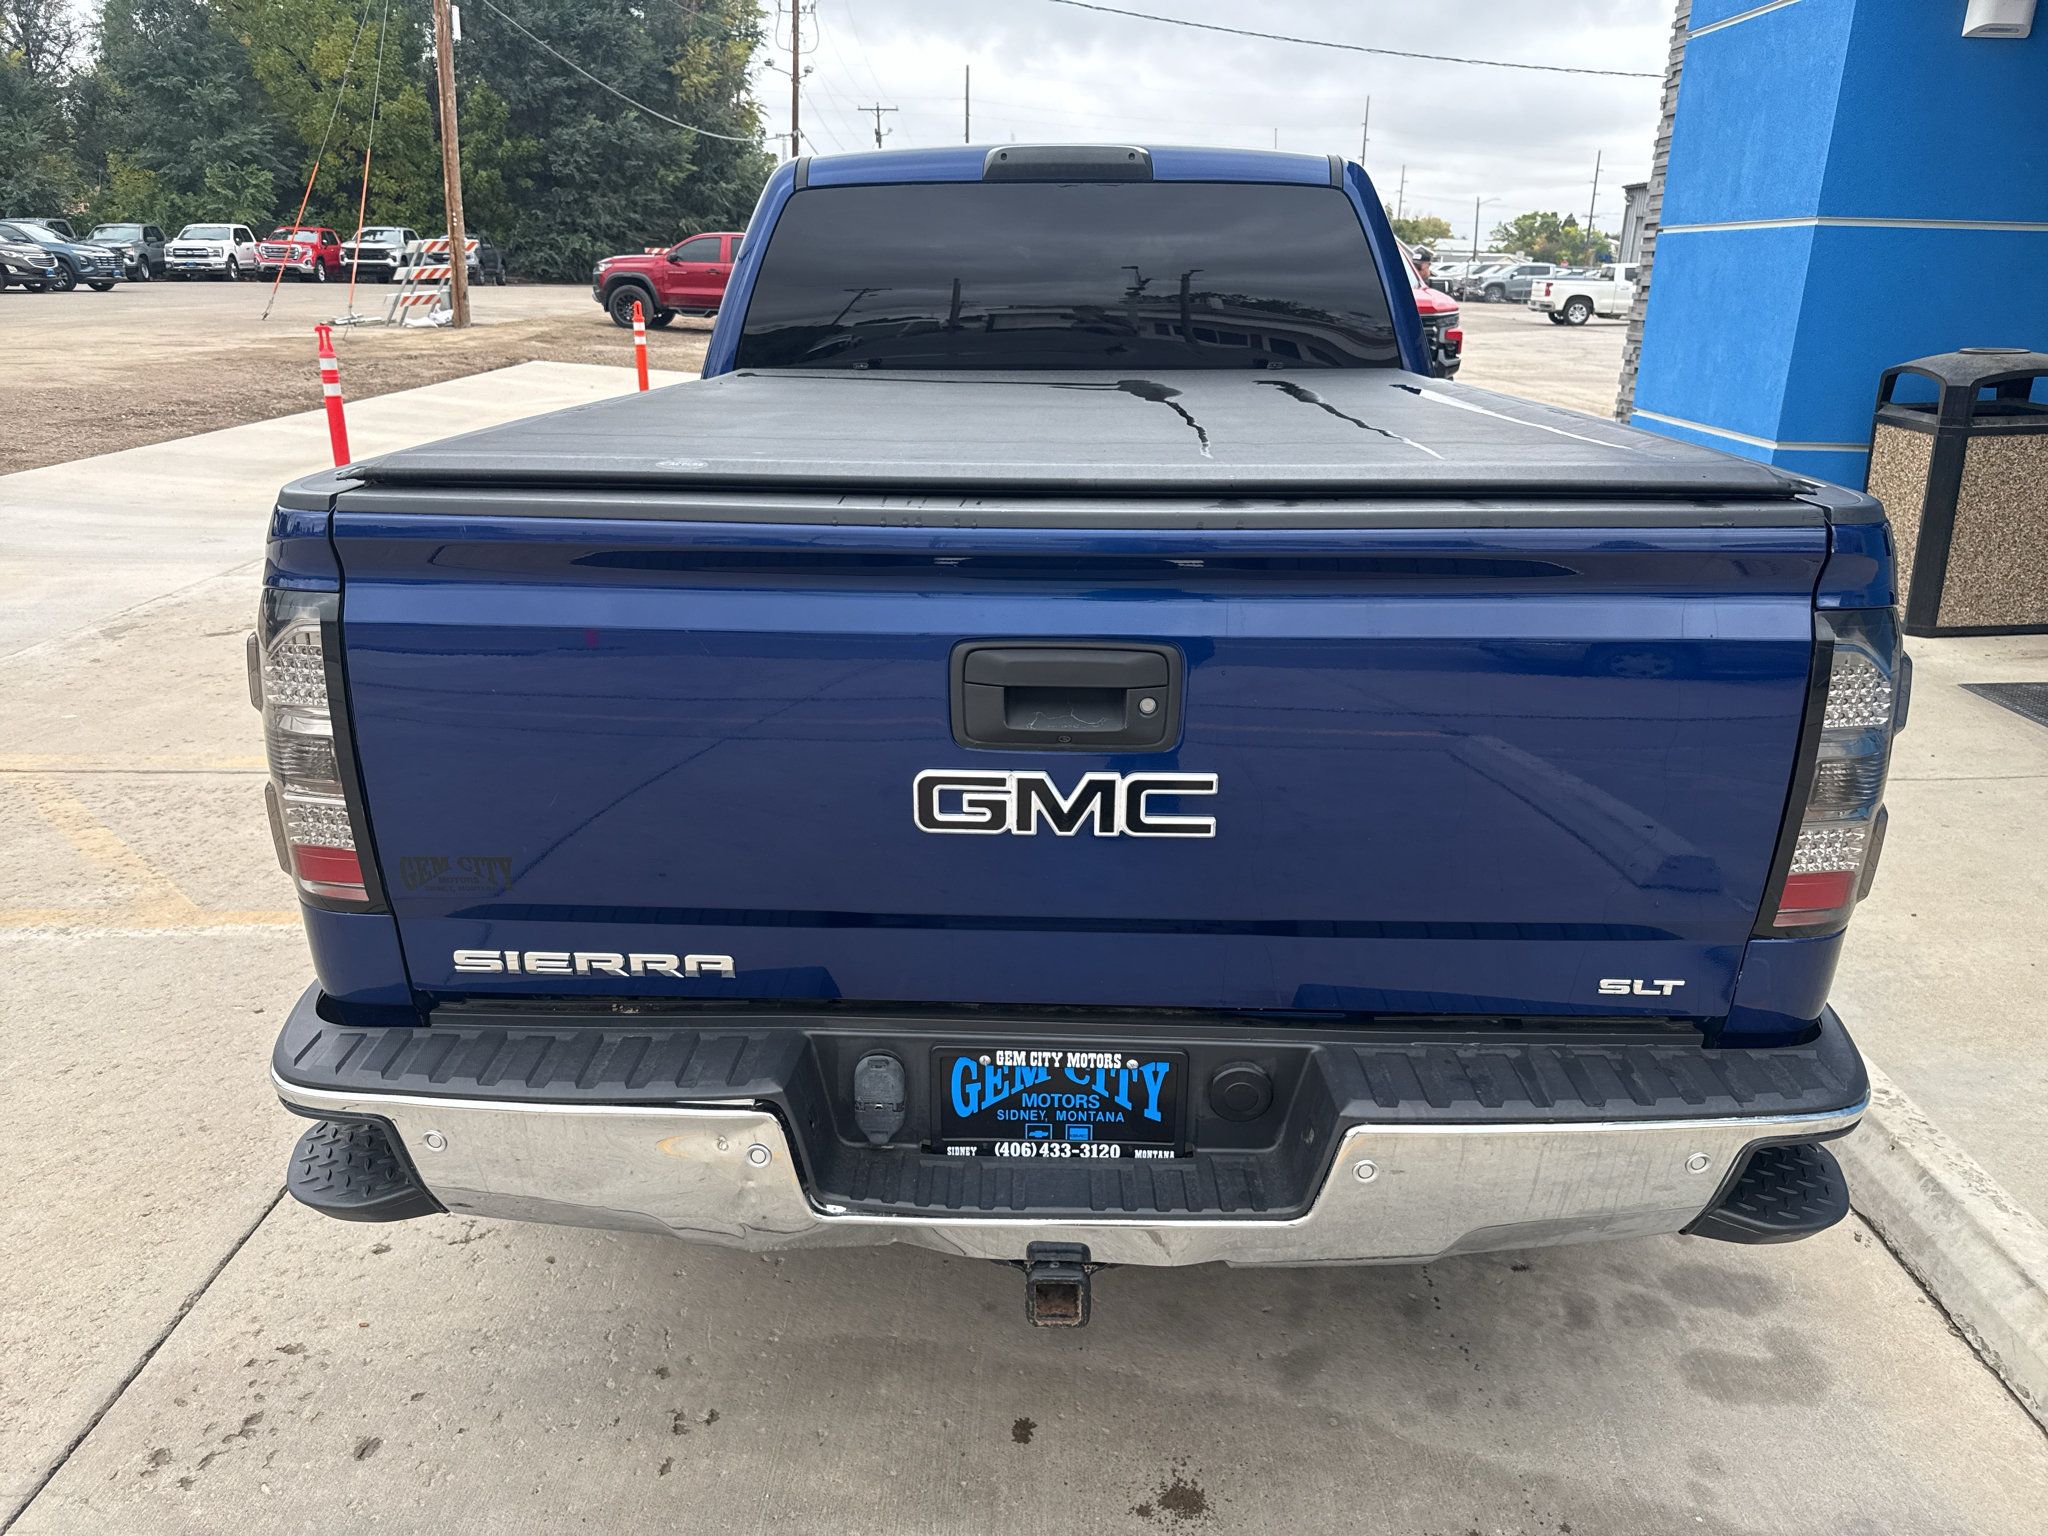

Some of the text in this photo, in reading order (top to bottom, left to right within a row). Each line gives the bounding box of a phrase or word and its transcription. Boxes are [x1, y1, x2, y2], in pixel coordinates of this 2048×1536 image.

[912, 769, 1219, 838] GMC
[400, 856, 513, 891] GEM CITY
[453, 950, 736, 978] SIERRA
[1598, 978, 1686, 995] SLT
[996, 1050, 1122, 1069] GEM CITY MOTORS
[1022, 1093, 1100, 1109] MOTORS
[996, 1109, 1125, 1122] SIDNEY, MONTANA
[947, 1146, 977, 1156] SIDNEY
[1134, 1149, 1175, 1159] MONTANA
